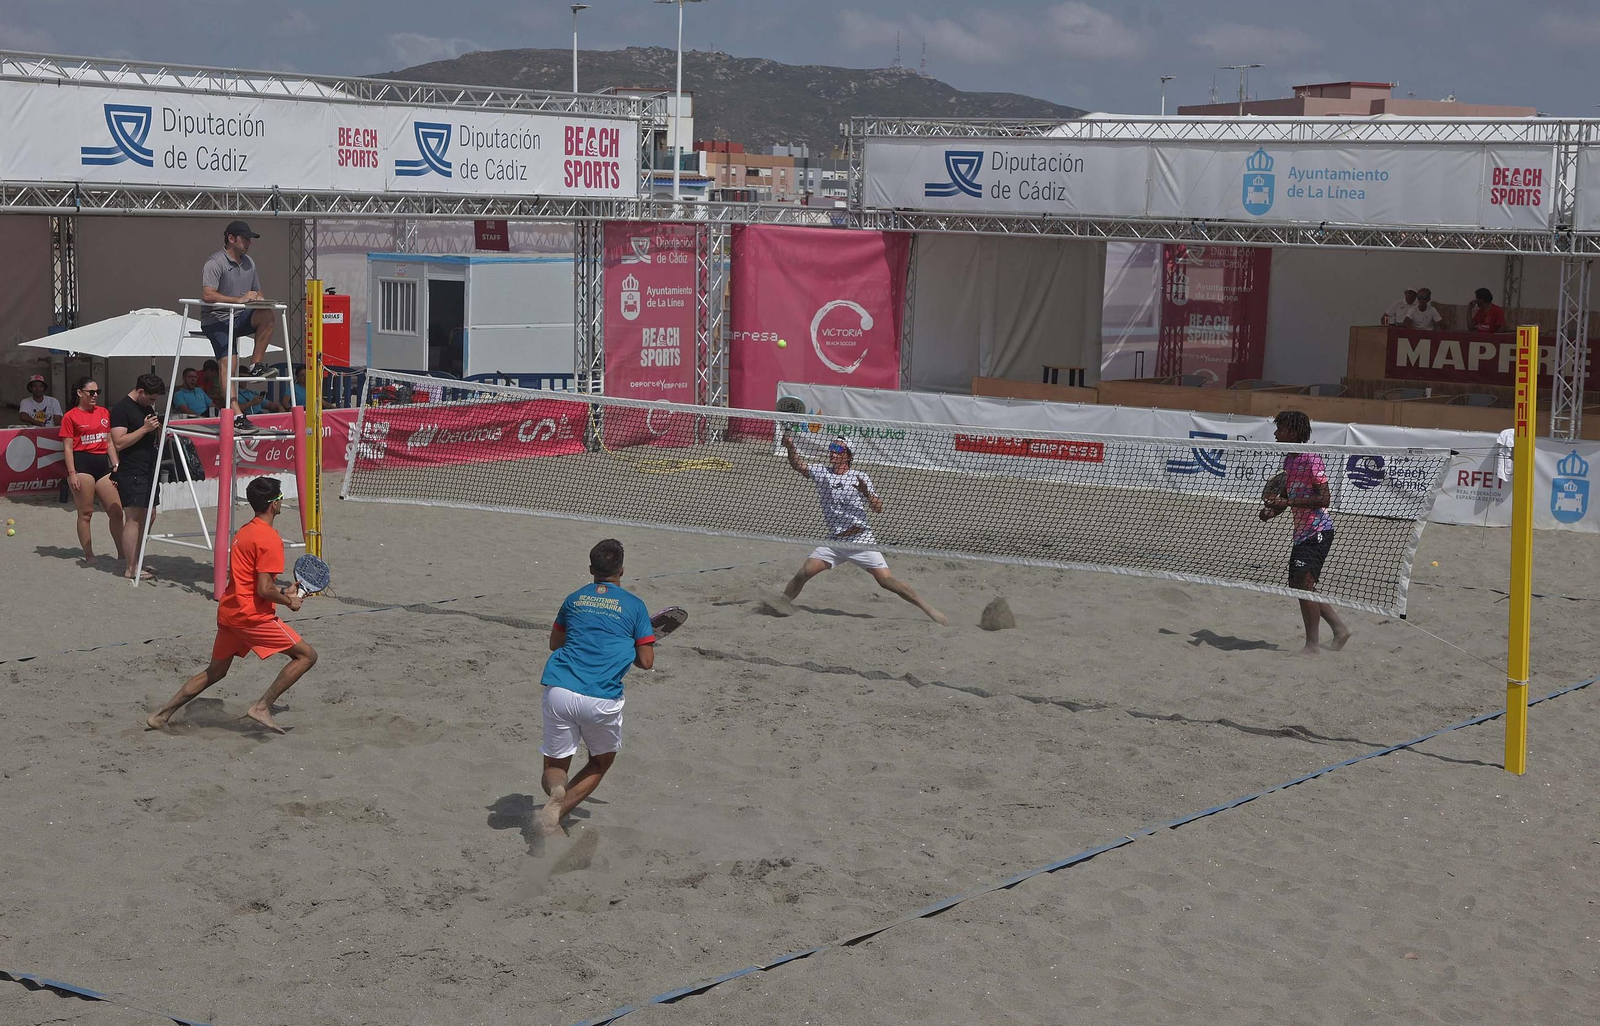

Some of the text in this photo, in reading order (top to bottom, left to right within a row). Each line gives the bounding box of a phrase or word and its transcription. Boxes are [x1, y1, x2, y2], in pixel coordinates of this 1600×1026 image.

[162, 107, 265, 137] Diputación
[338, 127, 378, 148] BEACH
[459, 125, 541, 150] Diputación
[564, 125, 620, 158] BEACH
[164, 145, 248, 172] de Cádiz
[338, 148, 378, 168] SPORTS
[991, 151, 1084, 174] Diputación
[460, 158, 527, 181] de Cádiz
[563, 160, 620, 190] SPORTS
[1288, 165, 1389, 184] Ayuntamiento
[1492, 167, 1542, 187] BEACH
[990, 180, 1066, 201] de Cádiz
[1287, 184, 1366, 200] de La Línea
[1490, 187, 1541, 206] SPORTS
[482, 233, 501, 241] STAFF
[656, 236, 693, 249] Diputación
[656, 252, 688, 264] de Cádiz
[1211, 246, 1256, 257] Diputación
[646, 286, 693, 297] Ayuntamiento
[1196, 283, 1251, 293] Ayuntamiento
[1217, 293, 1238, 301] Línea
[646, 298, 685, 307] de La Línea
[1189, 313, 1230, 331] BEACH
[642, 327, 680, 347] BEACH
[822, 328, 863, 337] VICTORIA
[1187, 328, 1229, 345] SPORTS
[640, 348, 681, 367] SPORTS
[1517, 330, 1529, 437] FUNTEC
[348, 422, 390, 440] BACH
[265, 447, 280, 460] de
[345, 443, 387, 460] SORTS
[1389, 465, 1426, 479] Beach
[7, 477, 62, 492] ESVÓLEY
[1389, 477, 1427, 491] Tennis
[1470, 489, 1501, 497] FEDERACIÓN
